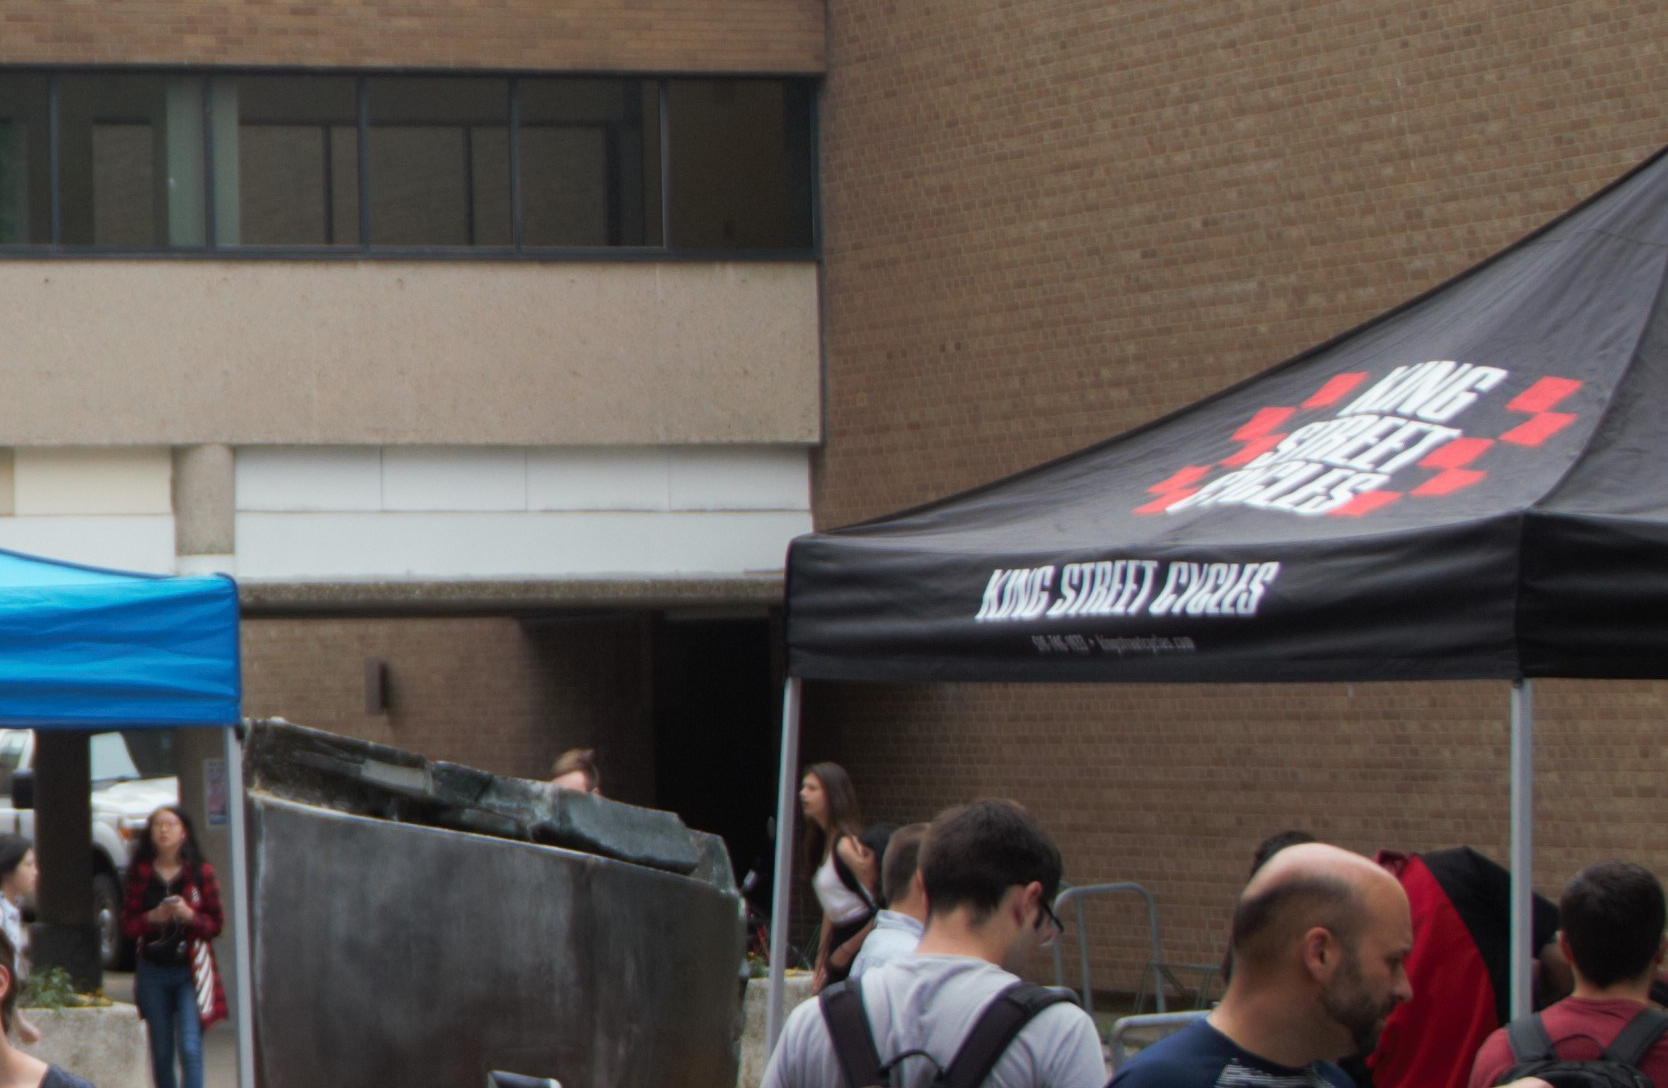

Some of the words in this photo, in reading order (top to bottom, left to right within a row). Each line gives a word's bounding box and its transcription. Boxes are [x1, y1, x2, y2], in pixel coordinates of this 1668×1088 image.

[1336, 360, 1509, 423] KING
[1242, 413, 1462, 475] STREET
[1165, 459, 1391, 516] CYCLES
[974, 564, 1056, 620] KING
[1046, 558, 1159, 618] STREET
[1148, 560, 1281, 617] CYCLES
